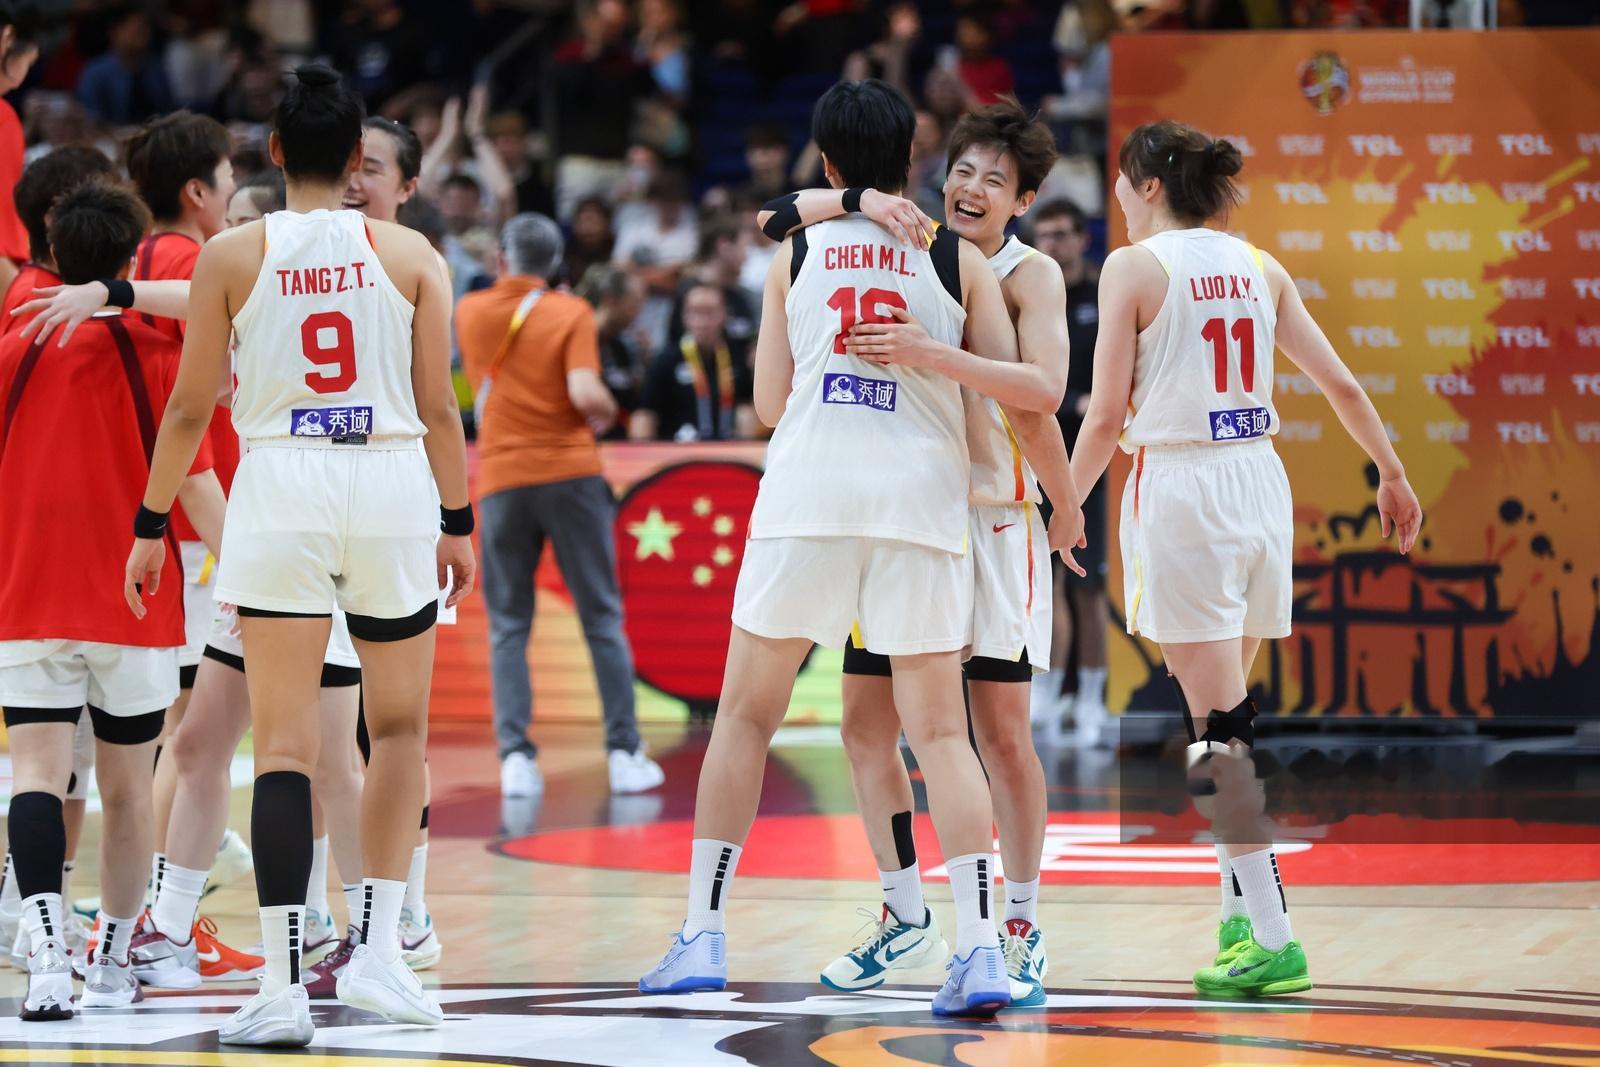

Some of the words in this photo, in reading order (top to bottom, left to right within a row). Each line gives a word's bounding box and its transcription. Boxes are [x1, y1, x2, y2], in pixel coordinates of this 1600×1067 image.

[1349, 134, 1403, 156] TCL
[1498, 134, 1552, 156] TCL
[1274, 183, 1328, 204] TCL
[1424, 183, 1477, 204] TCL
[1349, 231, 1402, 252] TCL
[1498, 231, 1551, 252] TCL
[825, 244, 874, 270] CHEN
[879, 245, 916, 277] M.L.
[276, 267, 332, 296] TANG
[334, 262, 374, 293] Z.T.
[1190, 275, 1226, 301] LUO
[1230, 275, 1258, 302] X.Y.
[1423, 279, 1476, 300] TCL
[1348, 327, 1402, 348] TCL
[1497, 327, 1551, 348] TCL
[301, 311, 357, 394] 9
[1201, 318, 1255, 393] 11
[859, 380, 894, 409] 秀域
[1423, 374, 1476, 396] TCL
[328, 409, 370, 435] 秀域
[1236, 410, 1268, 436] 秀域
[1497, 422, 1550, 444] TCL
